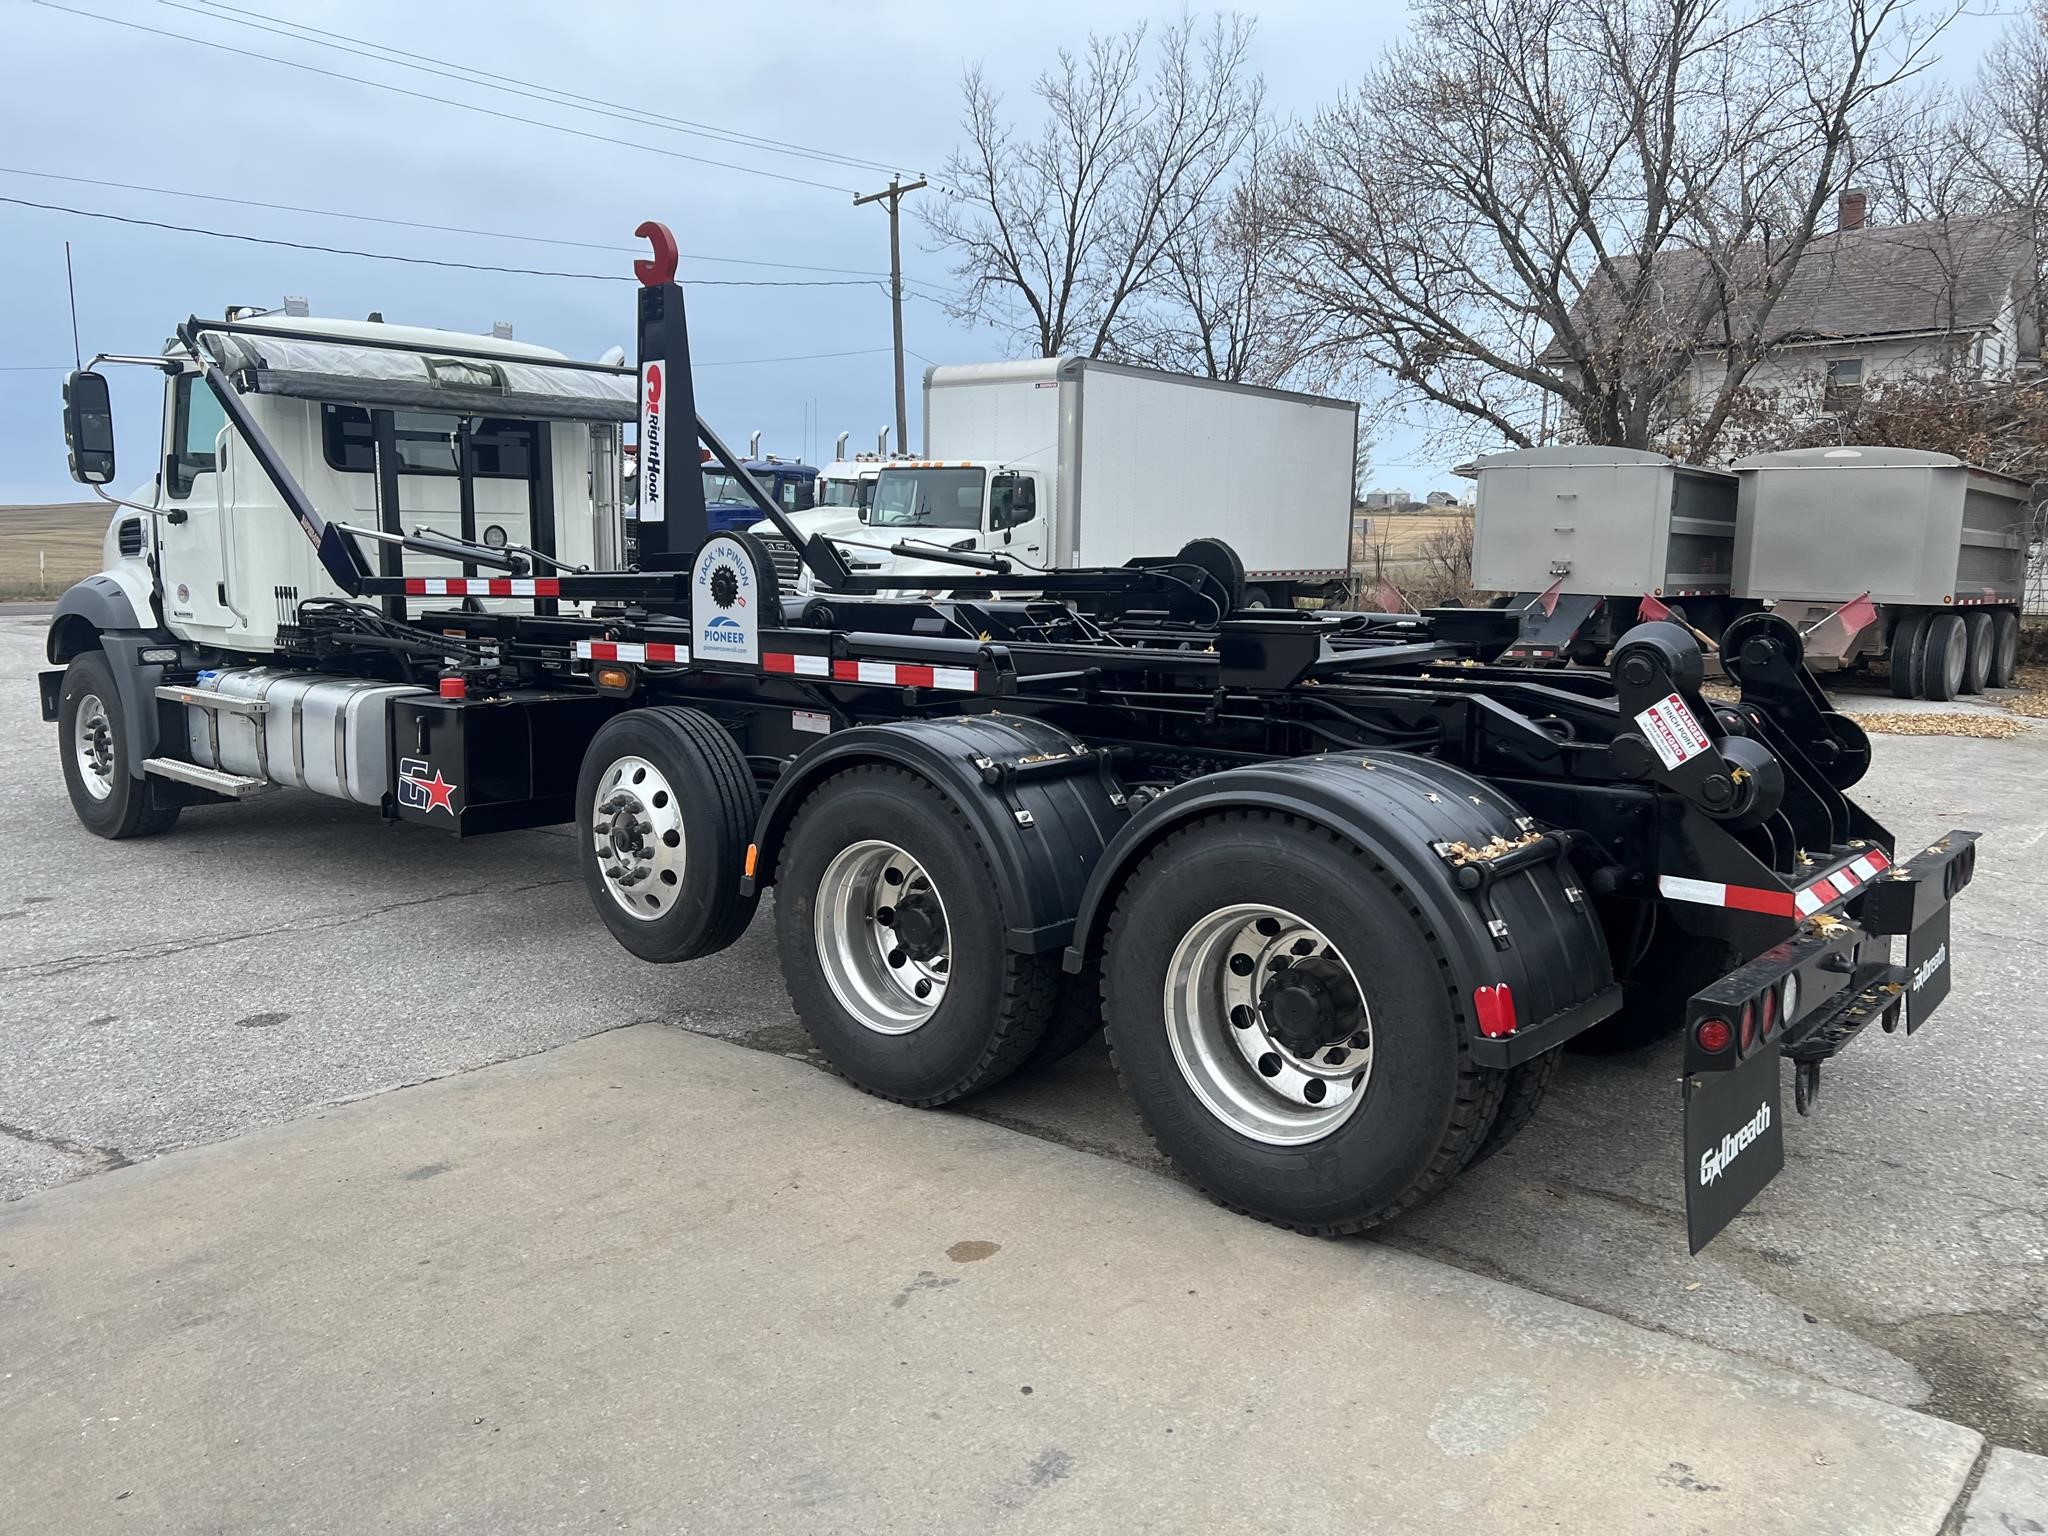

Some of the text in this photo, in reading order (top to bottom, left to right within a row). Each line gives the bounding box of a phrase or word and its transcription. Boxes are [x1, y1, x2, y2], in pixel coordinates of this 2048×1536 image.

[647, 414, 661, 504] RightHook
[699, 551, 716, 586] RACK
[726, 547, 750, 587] PINION
[704, 630, 745, 644] PIONEER
[1655, 720, 1683, 756] PELIGRO
[1663, 705, 1695, 749] PINCH POINT
[1678, 708, 1705, 744] DANGER
